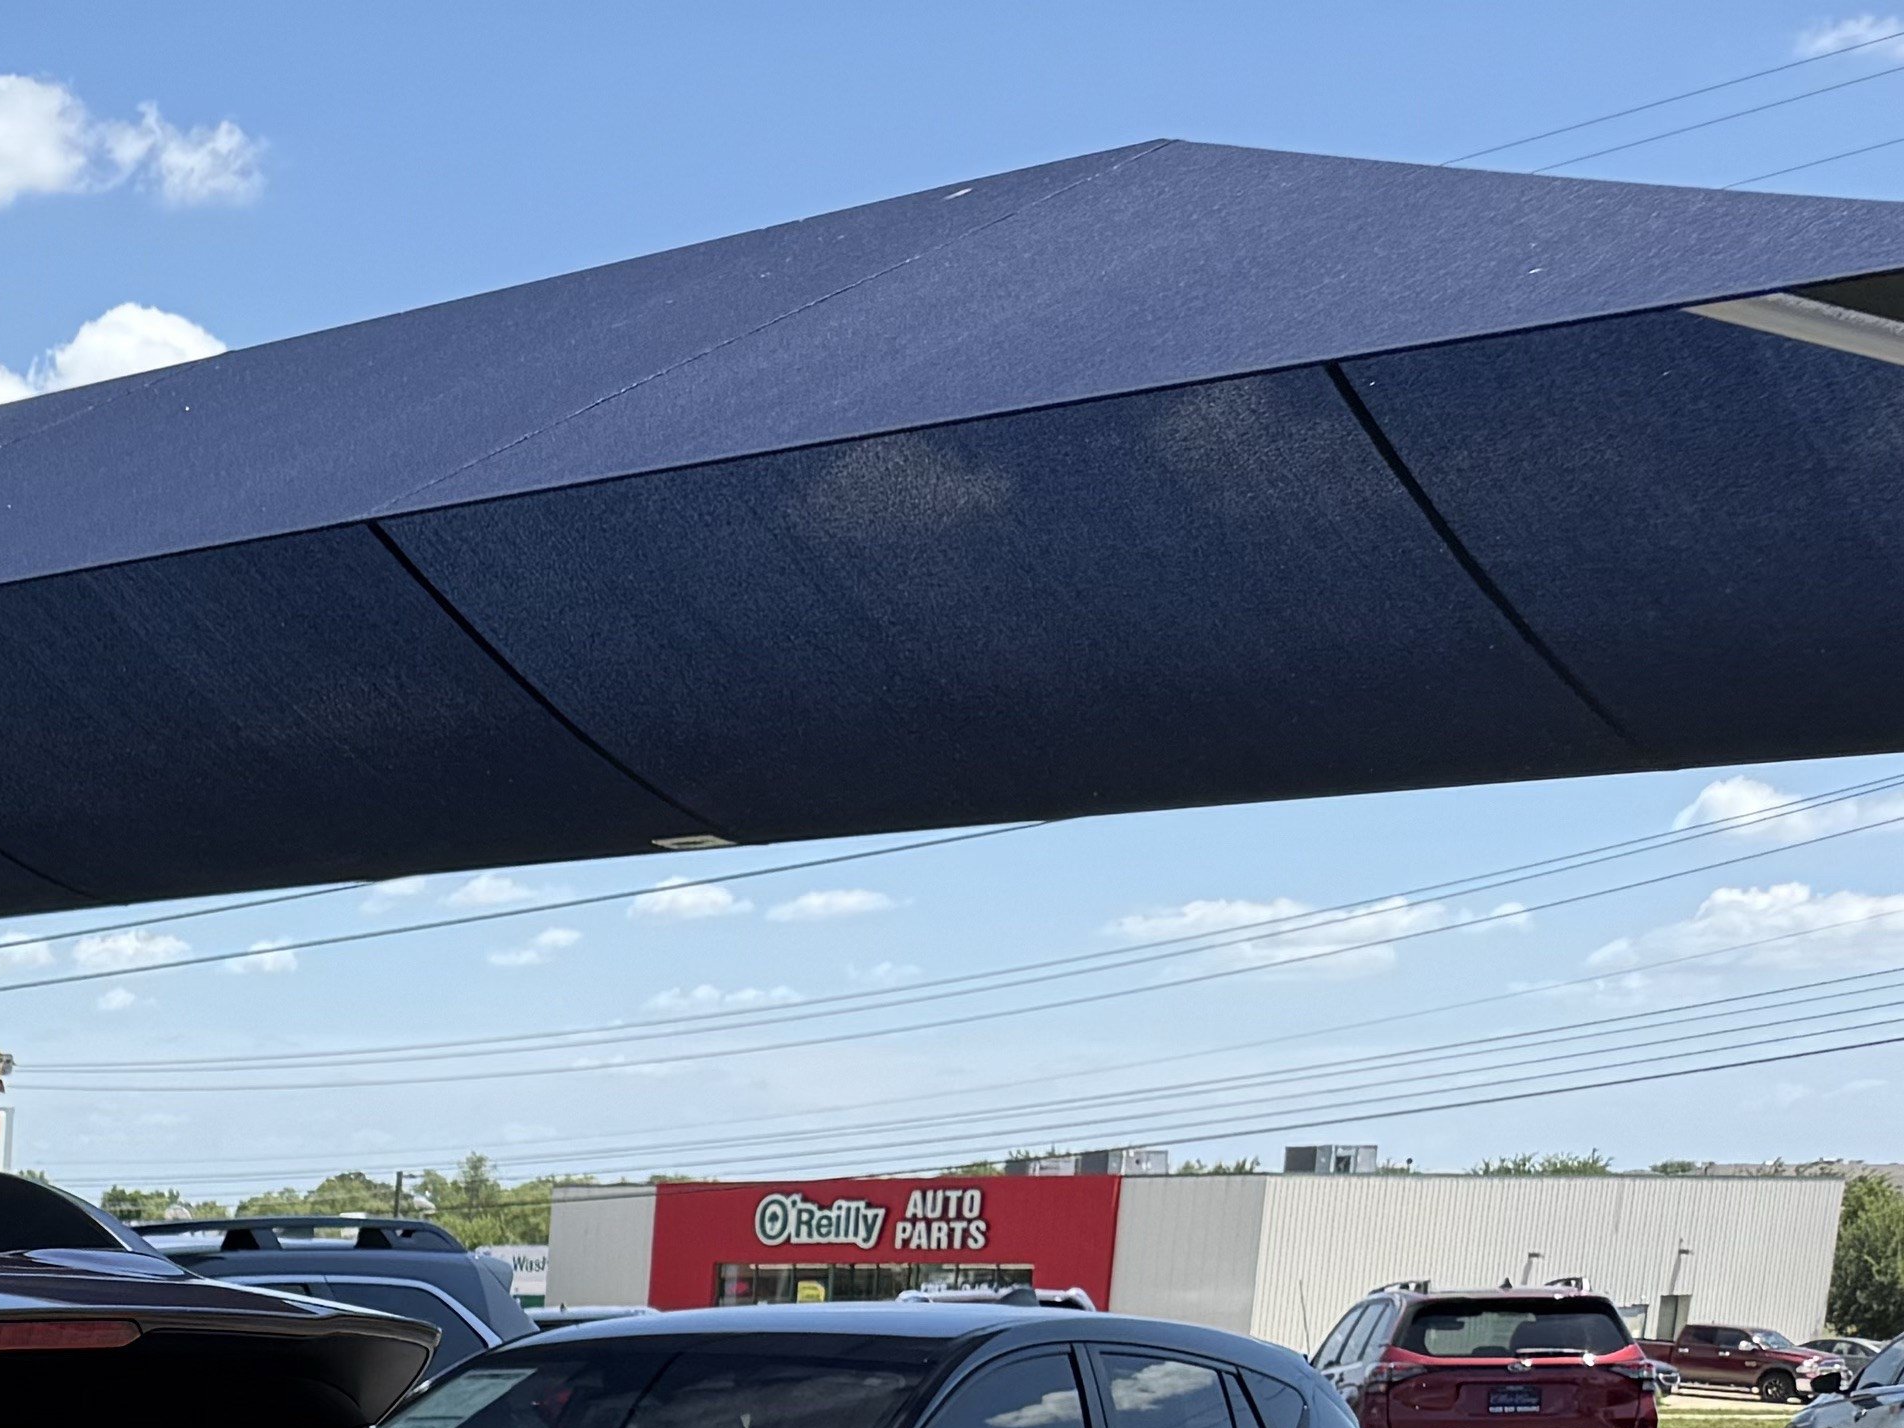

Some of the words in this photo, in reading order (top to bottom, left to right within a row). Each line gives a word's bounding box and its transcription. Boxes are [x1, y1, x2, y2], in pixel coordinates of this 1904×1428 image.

[906, 1189, 982, 1219] AUTO
[755, 1194, 886, 1249] O'Reilly
[895, 1220, 987, 1249] PARTS
